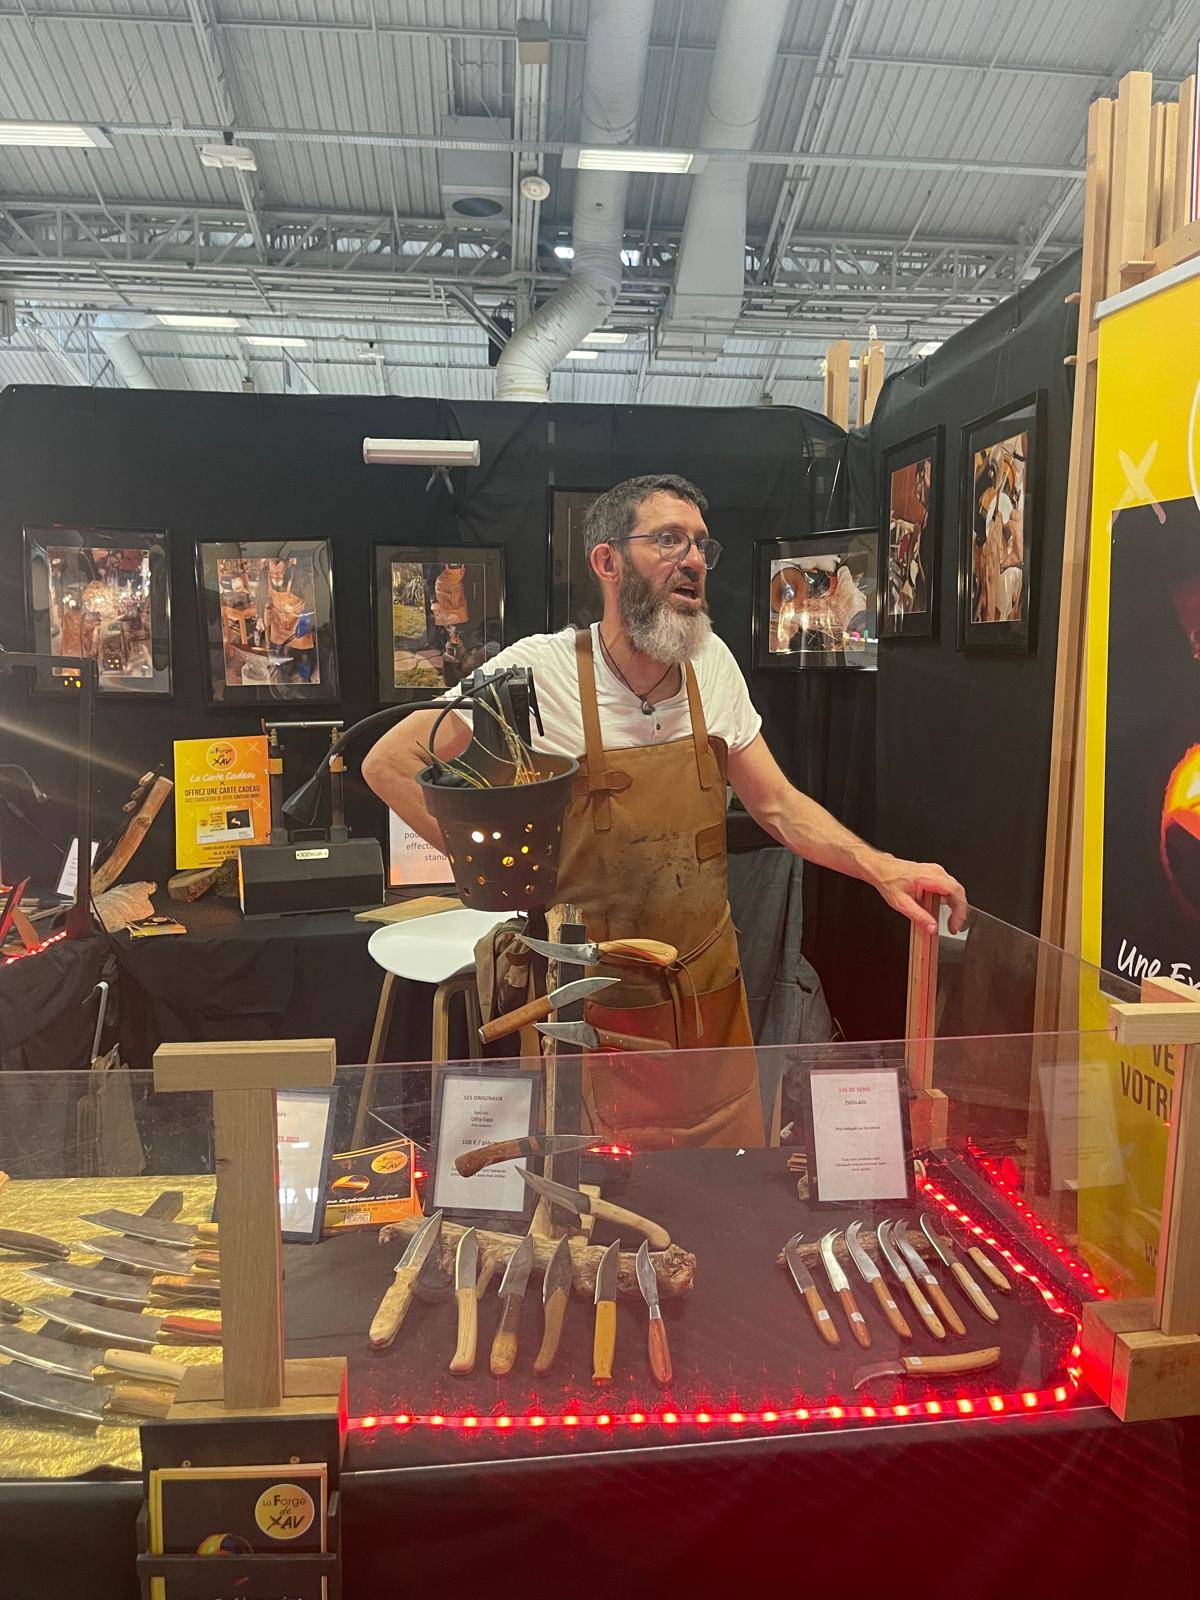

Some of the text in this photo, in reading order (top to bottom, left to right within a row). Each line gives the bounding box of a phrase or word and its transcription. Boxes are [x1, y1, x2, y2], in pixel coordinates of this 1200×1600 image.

[212, 758, 232, 766] XAV
[190, 770, 256, 783] La Carte Cadeau
[184, 785, 261, 797] OFFREZ UNE CARTE CADEAU
[1117, 938, 1162, 978] Une
[262, 1494, 307, 1508] La Forge
[279, 1504, 292, 1515] de
[266, 1515, 306, 1531] XAV
